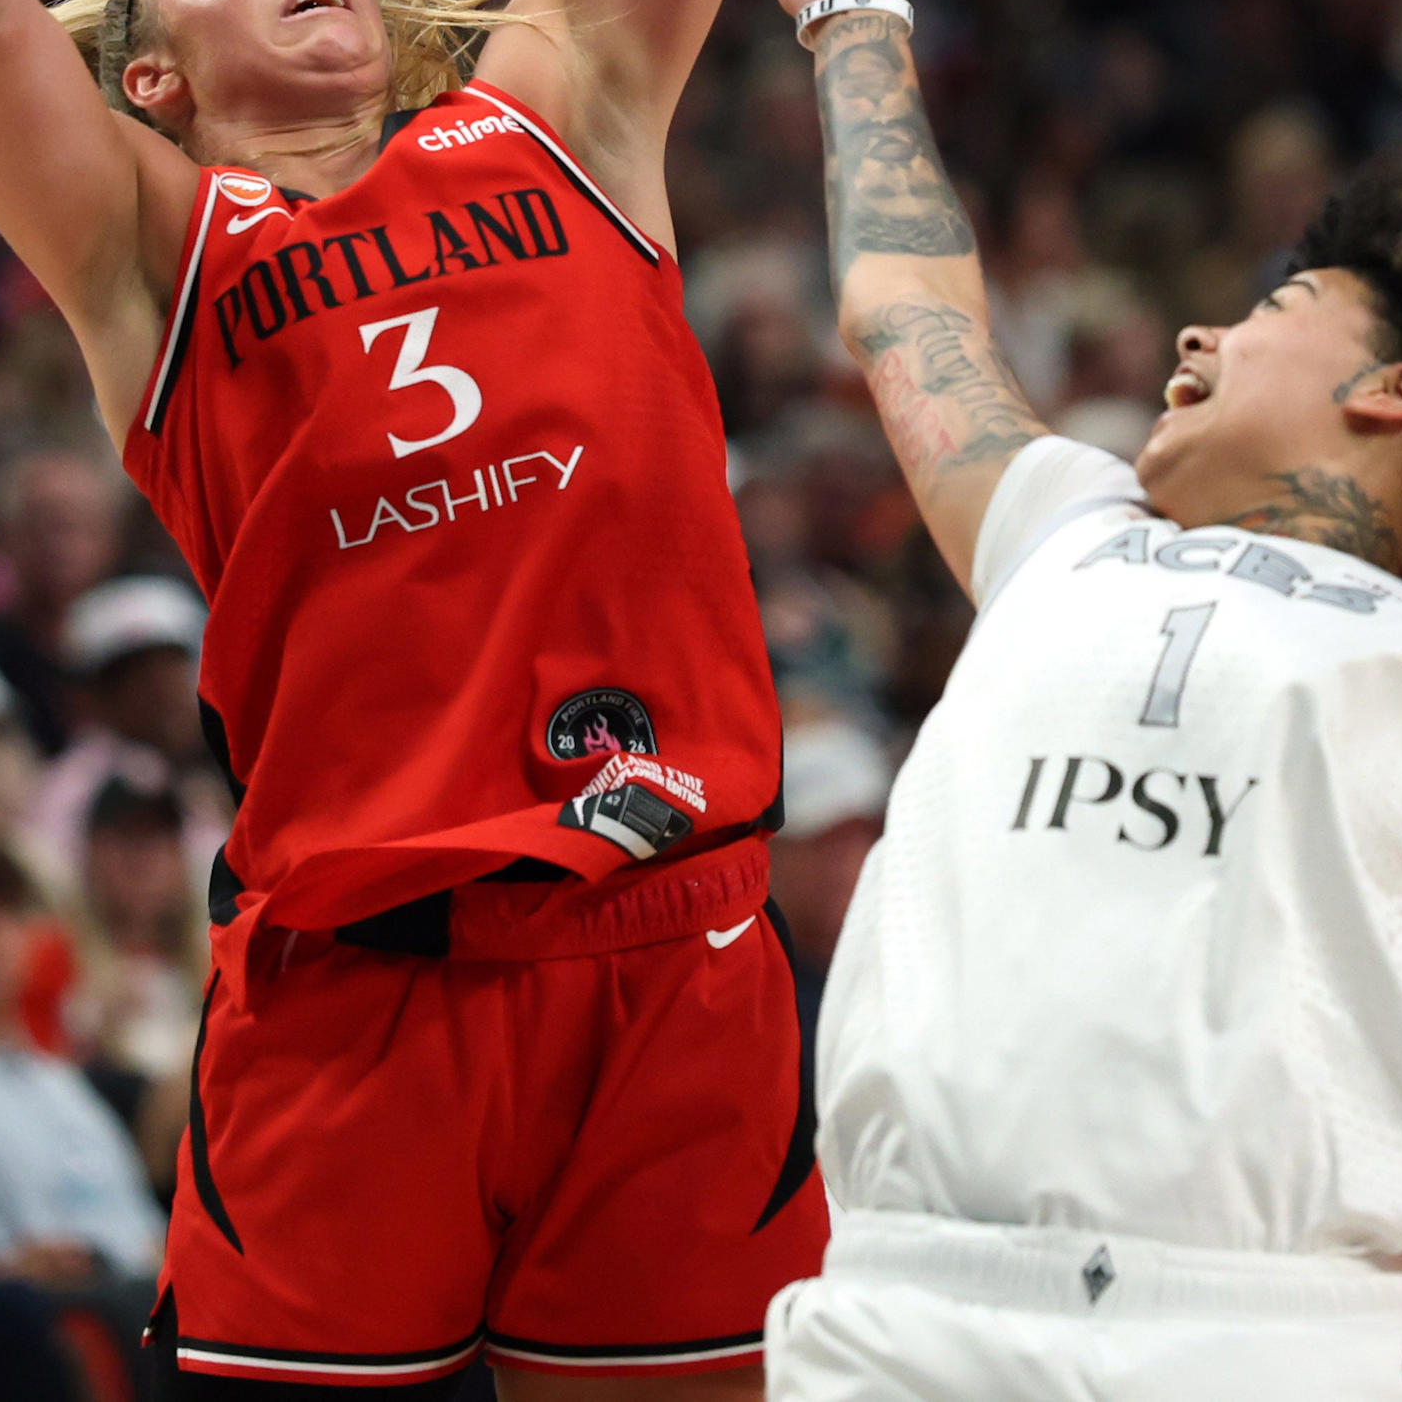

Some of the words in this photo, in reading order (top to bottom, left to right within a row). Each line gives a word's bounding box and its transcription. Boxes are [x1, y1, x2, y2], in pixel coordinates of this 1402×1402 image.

[418, 113, 526, 153] chime
[213, 188, 570, 368] PORTLAND
[358, 305, 483, 459] 3
[330, 444, 585, 549] LASHIFY
[560, 694, 625, 723] PORTLAND
[1138, 601, 1218, 729] 1
[557, 734, 576, 750] 20
[628, 739, 647, 754] 26
[1010, 755, 1260, 858] IPSY
